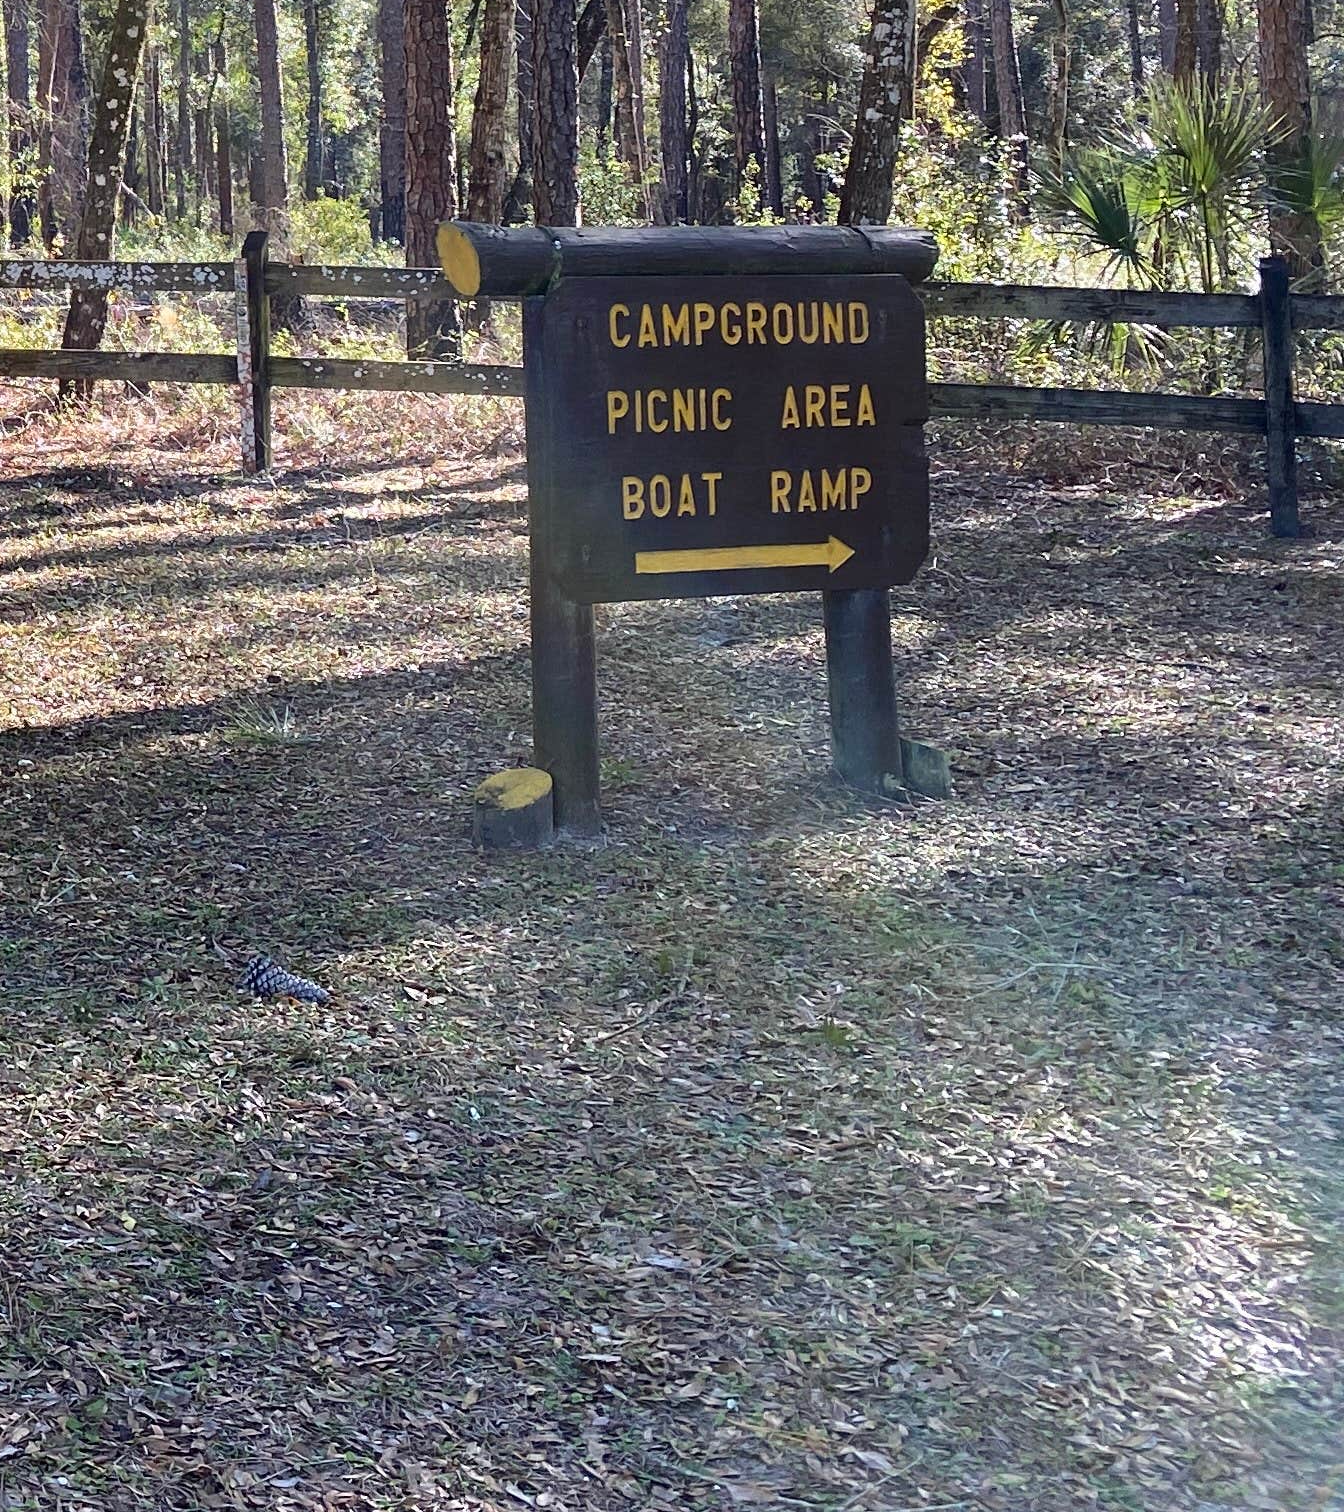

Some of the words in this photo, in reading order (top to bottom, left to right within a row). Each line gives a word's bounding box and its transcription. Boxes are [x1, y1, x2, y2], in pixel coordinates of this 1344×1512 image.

[608, 301, 871, 349] CAMPGROUND
[606, 387, 734, 434] PICNIC
[781, 383, 878, 429] AREA
[622, 471, 723, 521] BOAT
[770, 467, 873, 512] RAMP
